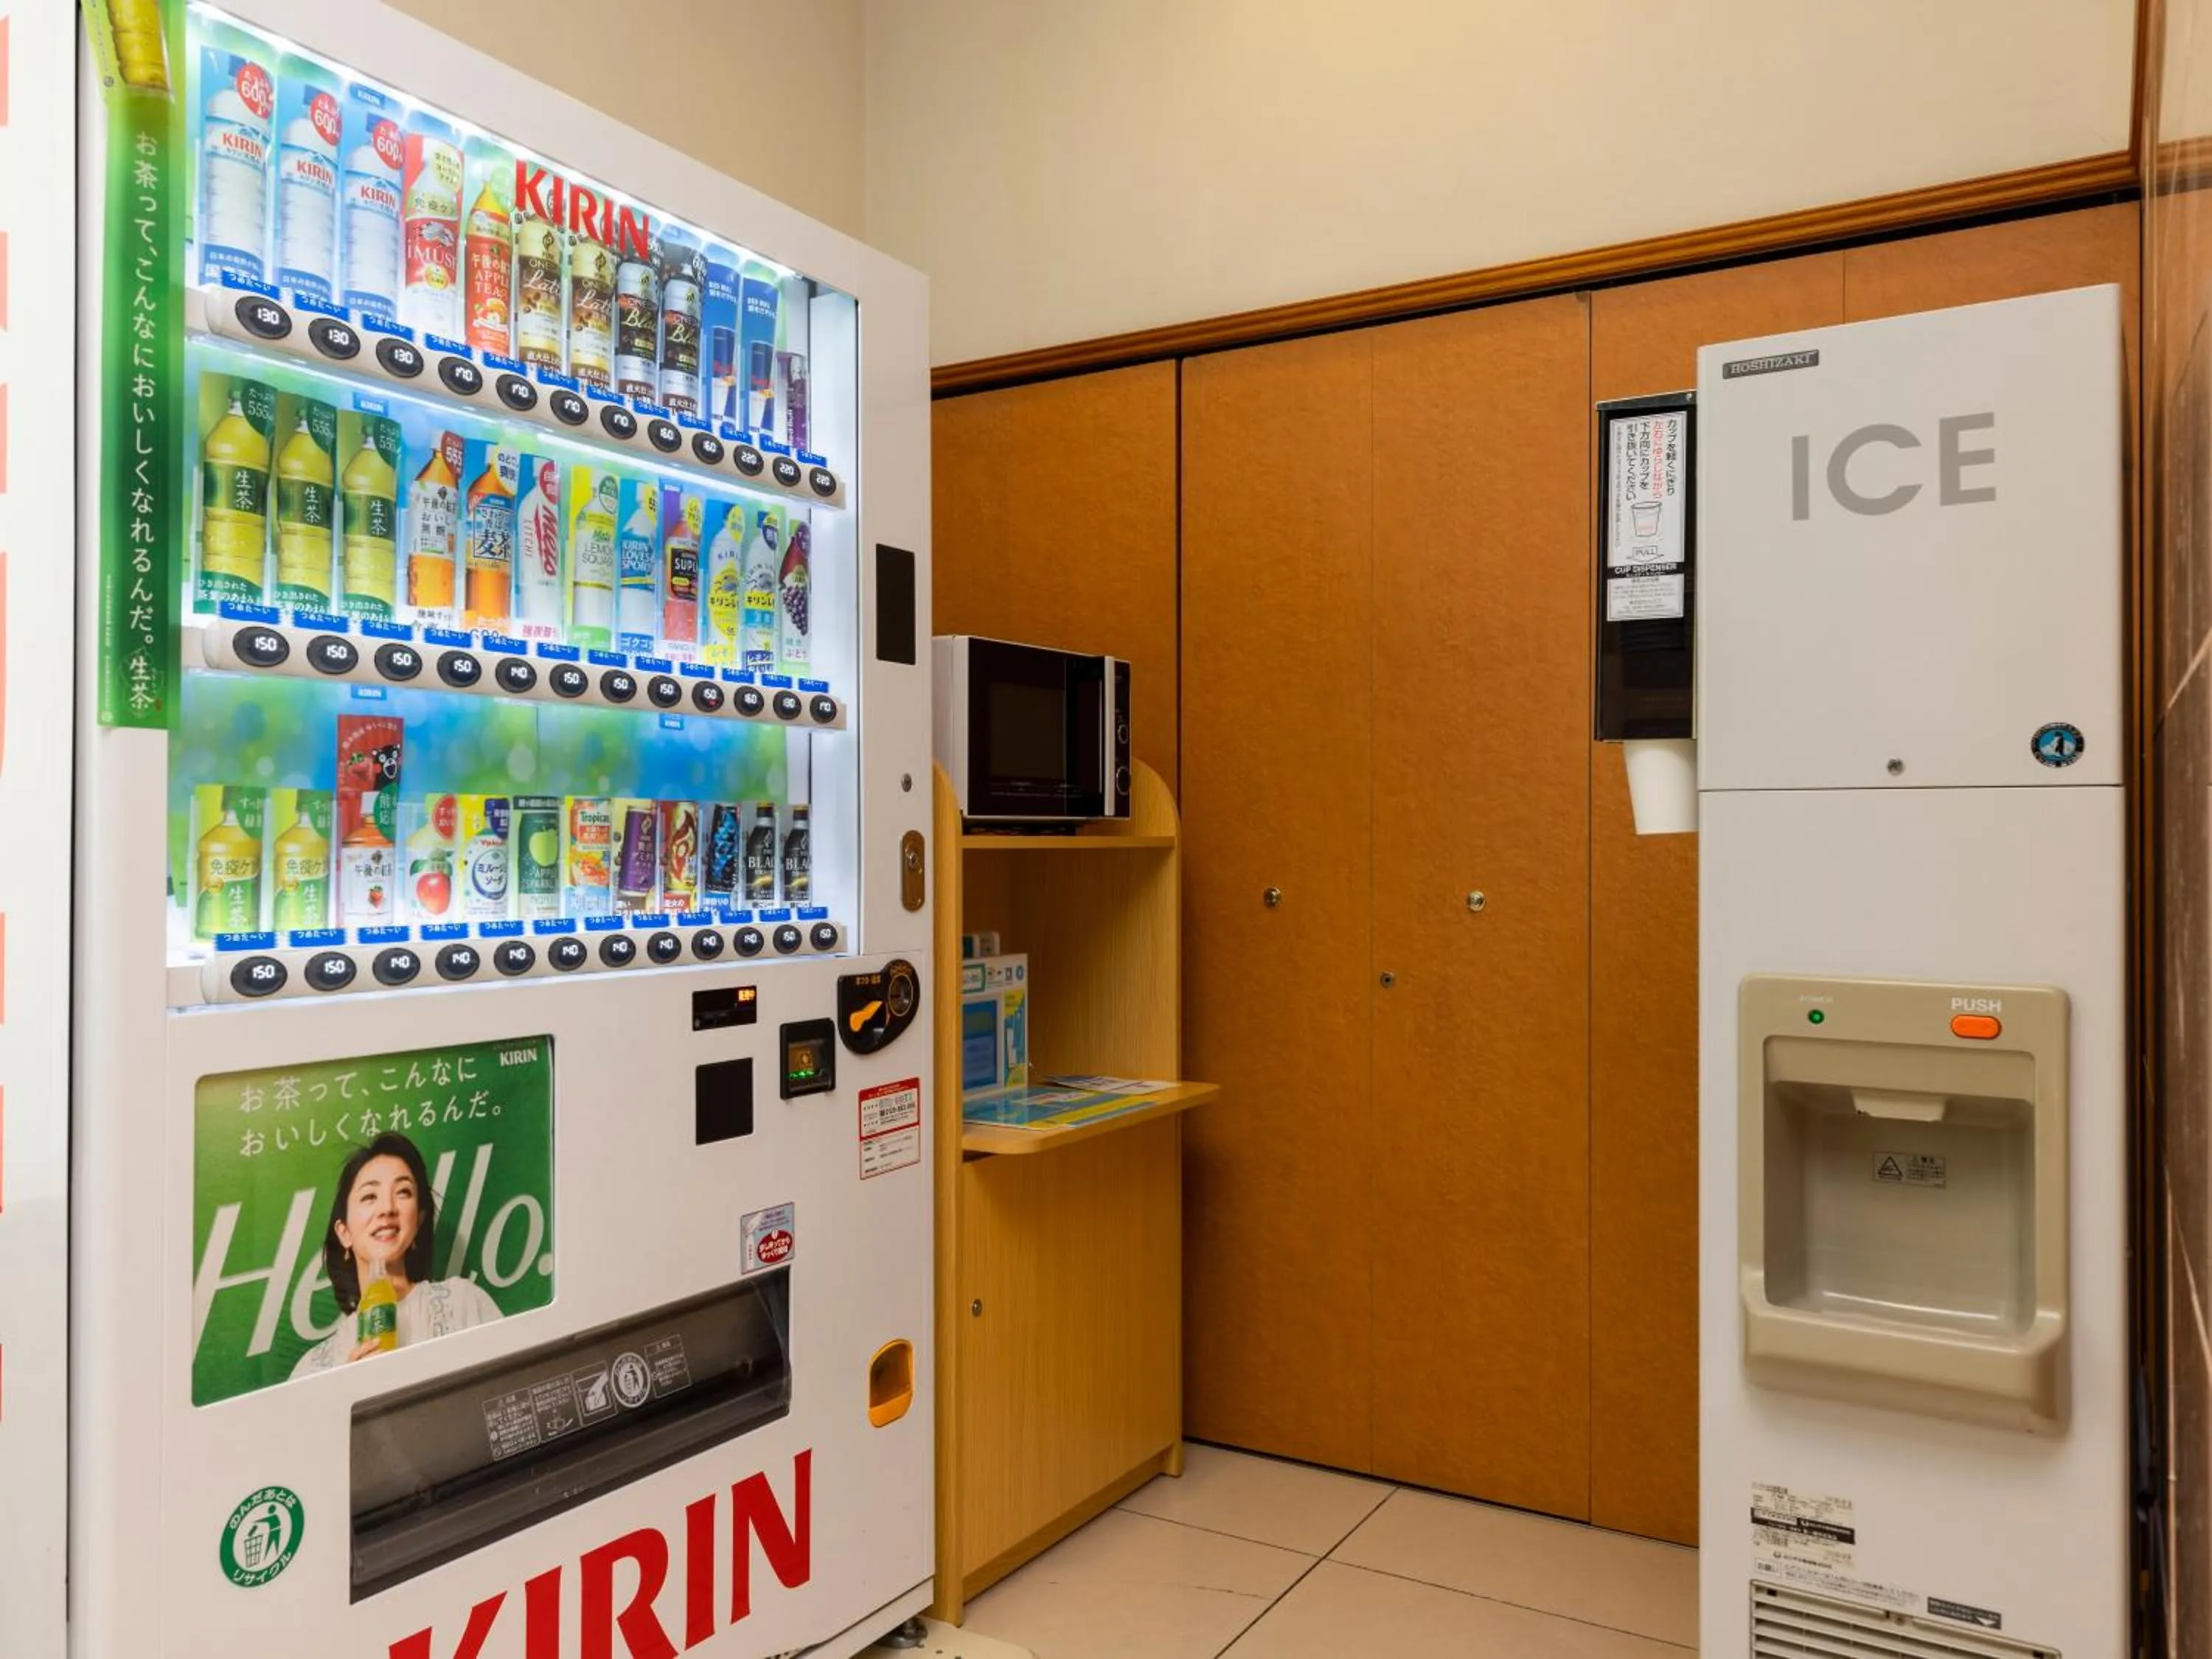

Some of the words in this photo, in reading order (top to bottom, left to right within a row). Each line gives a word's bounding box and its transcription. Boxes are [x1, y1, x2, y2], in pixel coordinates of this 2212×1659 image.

[223, 133, 262, 158] KIRIN
[296, 159, 331, 184] KIRIN
[361, 184, 396, 207] KIRIN
[515, 159, 650, 262] KIRIN
[257, 307, 280, 325] 130
[328, 329, 349, 346] 130
[394, 348, 414, 365] 130
[1730, 352, 1814, 375] HOSHIZAKI
[741, 451, 757, 465] 220
[779, 462, 794, 476] 220
[1791, 411, 1997, 521] ICE
[235, 470, 254, 510] 生茶
[305, 486, 321, 523] 生茶
[371, 500, 387, 536] 生茶
[1615, 566, 1632, 574] CUP
[254, 636, 278, 652] 150
[326, 644, 348, 659] 150
[392, 652, 412, 667] 150
[453, 659, 473, 673] 150
[510, 666, 528, 679] 140
[563, 672, 580, 684] 150
[129, 656, 156, 710] 生茶
[613, 678, 629, 690] 150
[660, 683, 674, 695] 150
[659, 939, 674, 950] 140
[703, 936, 717, 947] 140
[744, 933, 757, 944] 140
[509, 947, 526, 961] 140
[562, 944, 579, 956] 140
[613, 941, 627, 953] 140
[390, 955, 411, 969] 140
[452, 951, 470, 964] 140
[252, 964, 276, 980] 150
[324, 959, 346, 974] 150
[1951, 997, 2002, 1012] PUSH
[500, 1048, 538, 1067] KIRIN
[239, 1057, 478, 1114] お茶って、こんなに
[239, 1090, 501, 1158] おいしくなれるんだ。
[229, 1489, 296, 1530] のんだあとは
[233, 1552, 291, 1585] リサイクル
